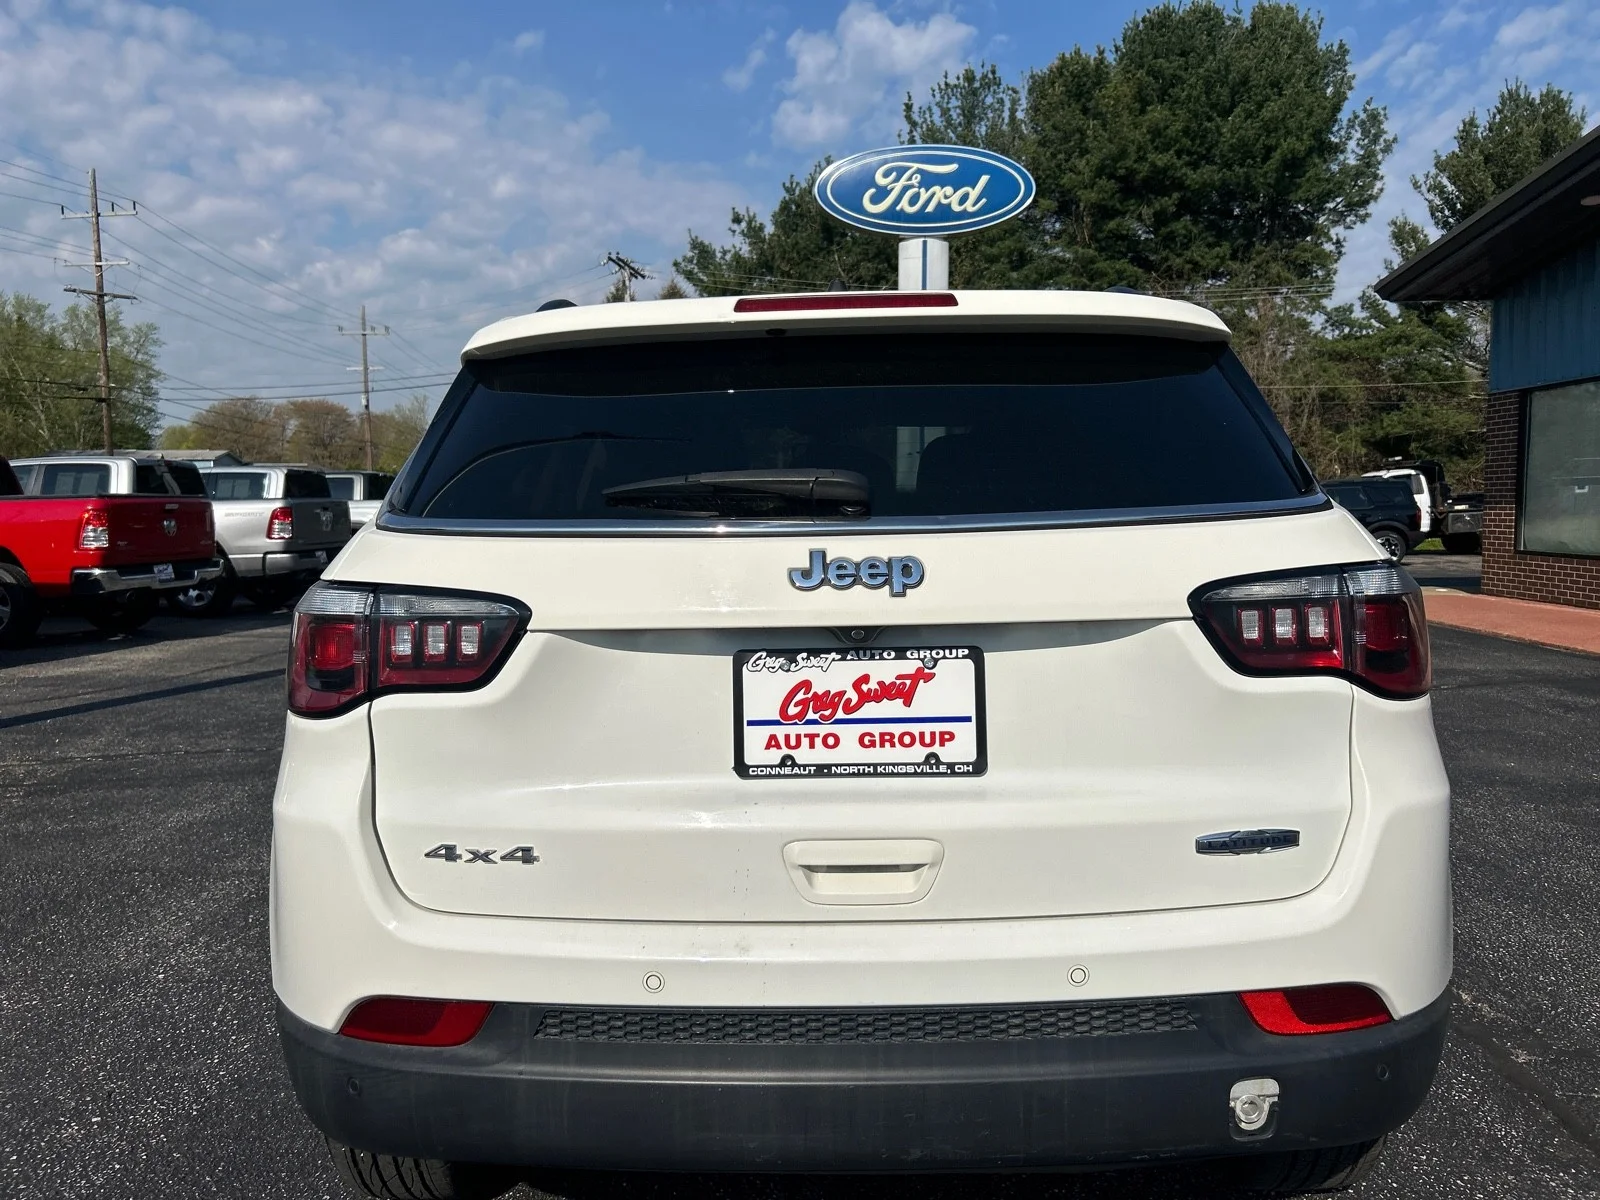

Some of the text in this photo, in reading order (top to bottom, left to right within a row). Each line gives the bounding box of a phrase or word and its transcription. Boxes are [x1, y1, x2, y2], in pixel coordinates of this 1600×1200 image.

[862, 161, 990, 214] Ford
[788, 548, 924, 597] Jeep
[747, 649, 969, 672] Greg Sweet AUTO GROUP
[779, 667, 936, 723] Greg Sweet
[764, 731, 956, 750] AUTO GROUP
[749, 767, 816, 775] CONNEAUT
[831, 766, 874, 774] NORTH
[877, 765, 951, 774] KINGSVILLE,
[954, 765, 973, 773] OH
[1207, 834, 1293, 849] LATITUDE
[424, 843, 540, 865] 4x4
